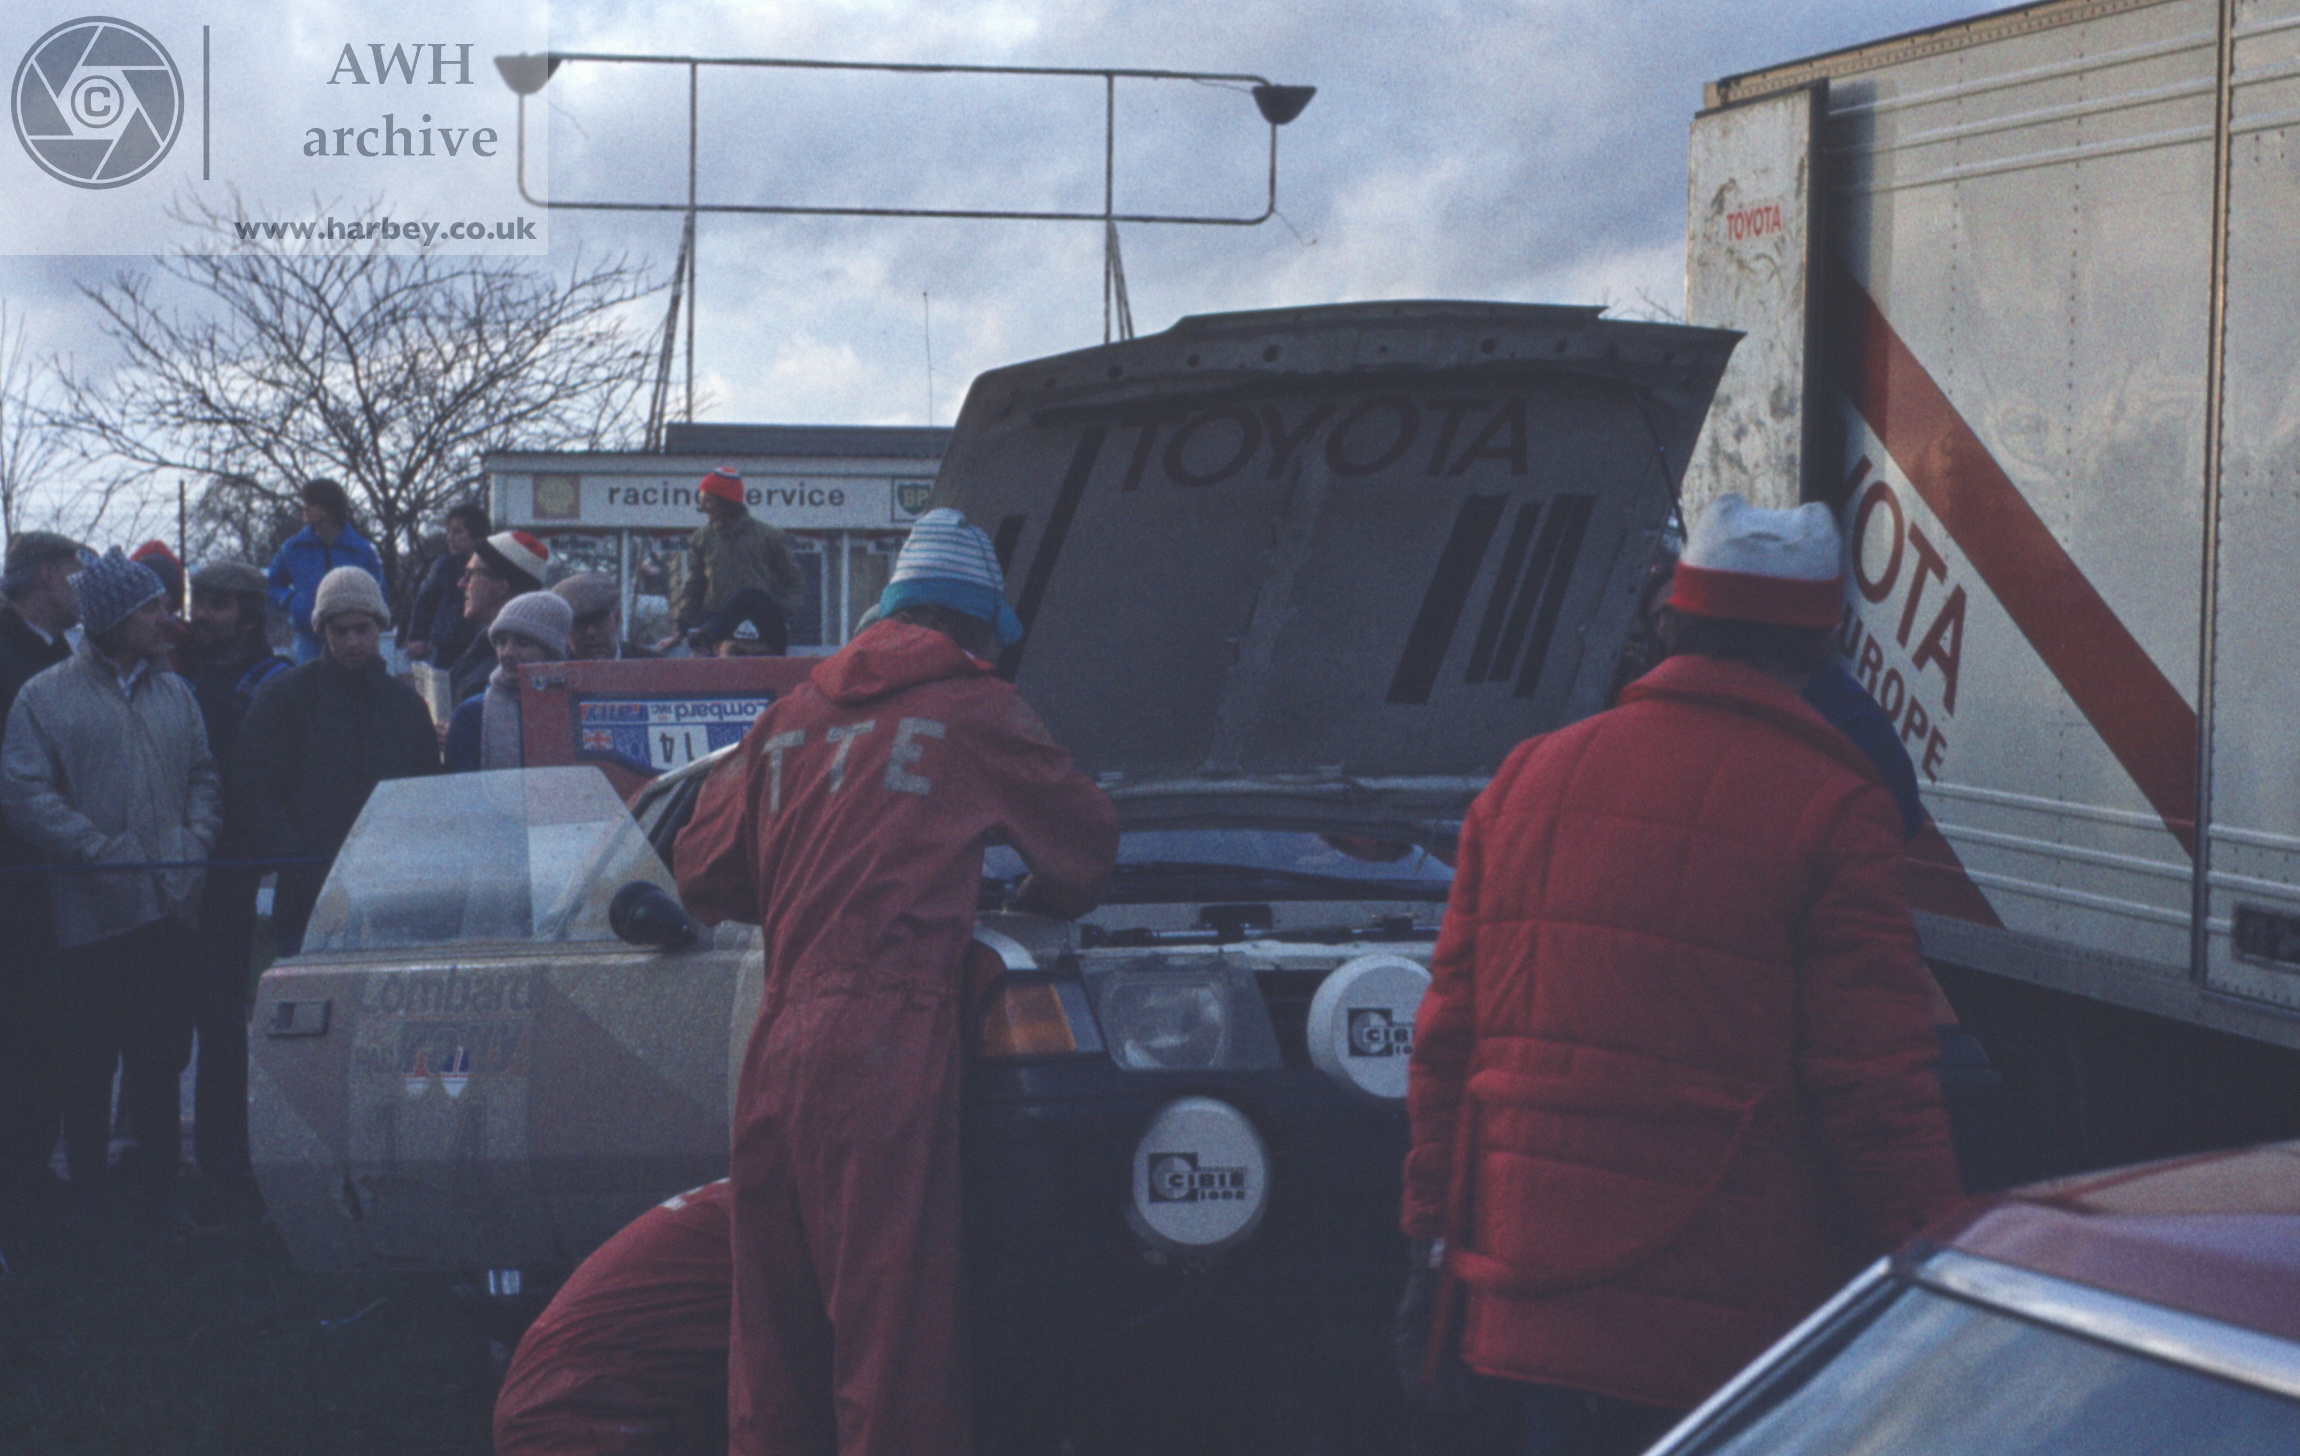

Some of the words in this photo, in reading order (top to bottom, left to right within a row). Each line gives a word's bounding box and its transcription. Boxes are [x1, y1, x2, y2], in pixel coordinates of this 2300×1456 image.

[1726, 205, 1782, 241] TOYOTA
[1121, 395, 1529, 492] TOYOTA
[746, 482, 845, 507] ervice
